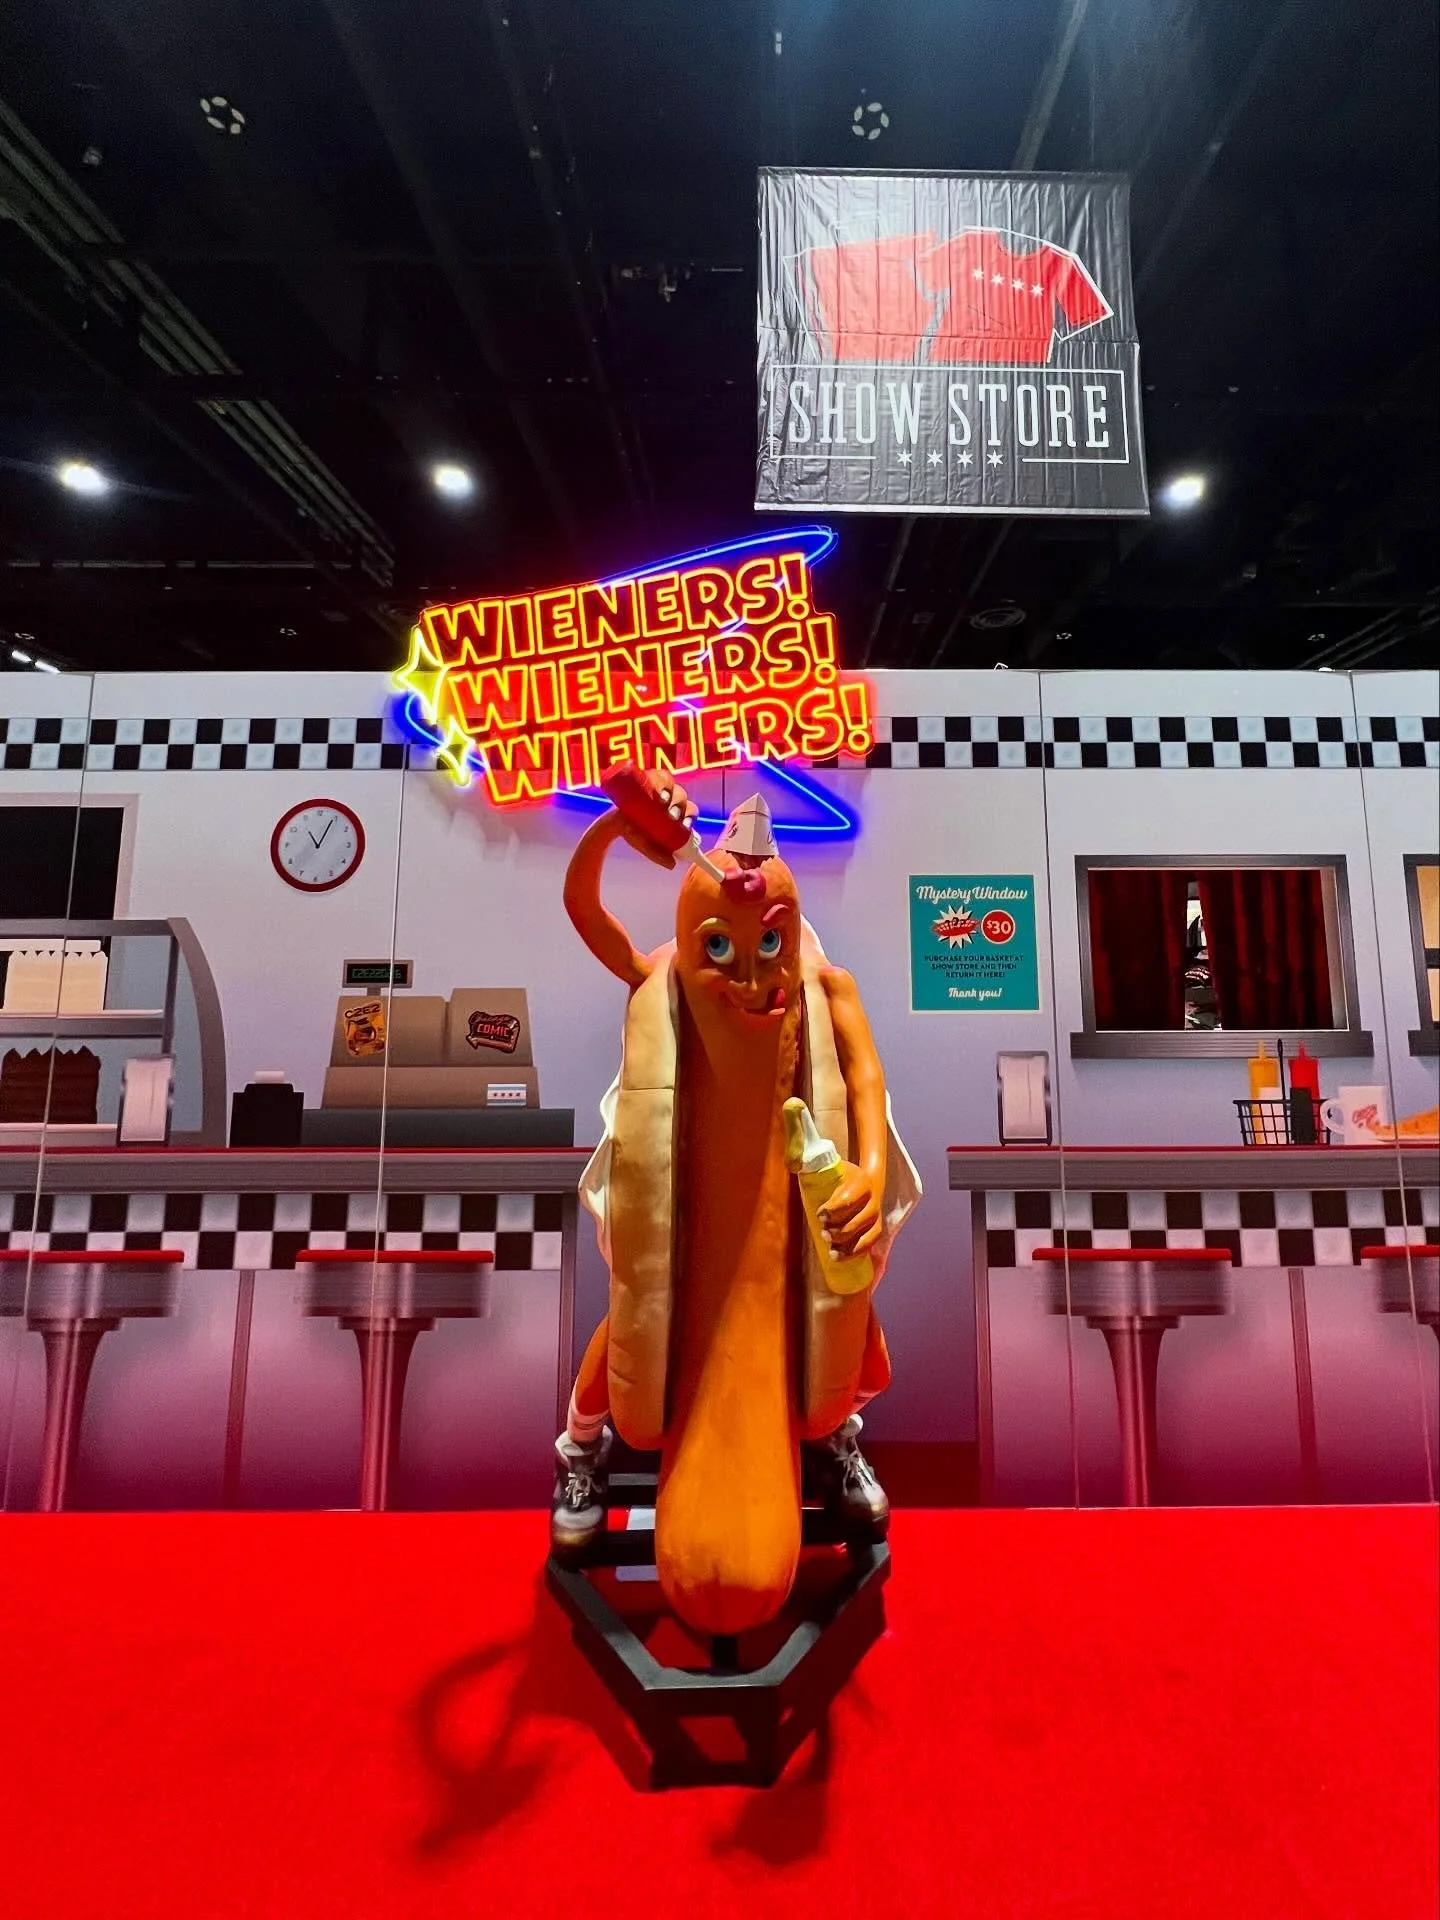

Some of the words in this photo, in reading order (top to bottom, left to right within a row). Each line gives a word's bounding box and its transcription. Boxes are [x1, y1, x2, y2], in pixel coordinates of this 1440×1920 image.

[788, 381, 924, 445] SHOW
[948, 382, 1110, 449] STORE
[423, 551, 812, 669] WIENERS!
[447, 615, 838, 735] WIENERS!
[916, 885, 971, 905] Mystery
[972, 886, 1028, 900] Window
[986, 920, 1012, 935] $30
[948, 987, 977, 998] Thank
[979, 987, 1003, 1001] you!
[344, 1003, 380, 1019] C2E2
[476, 1023, 510, 1037] COMIC
